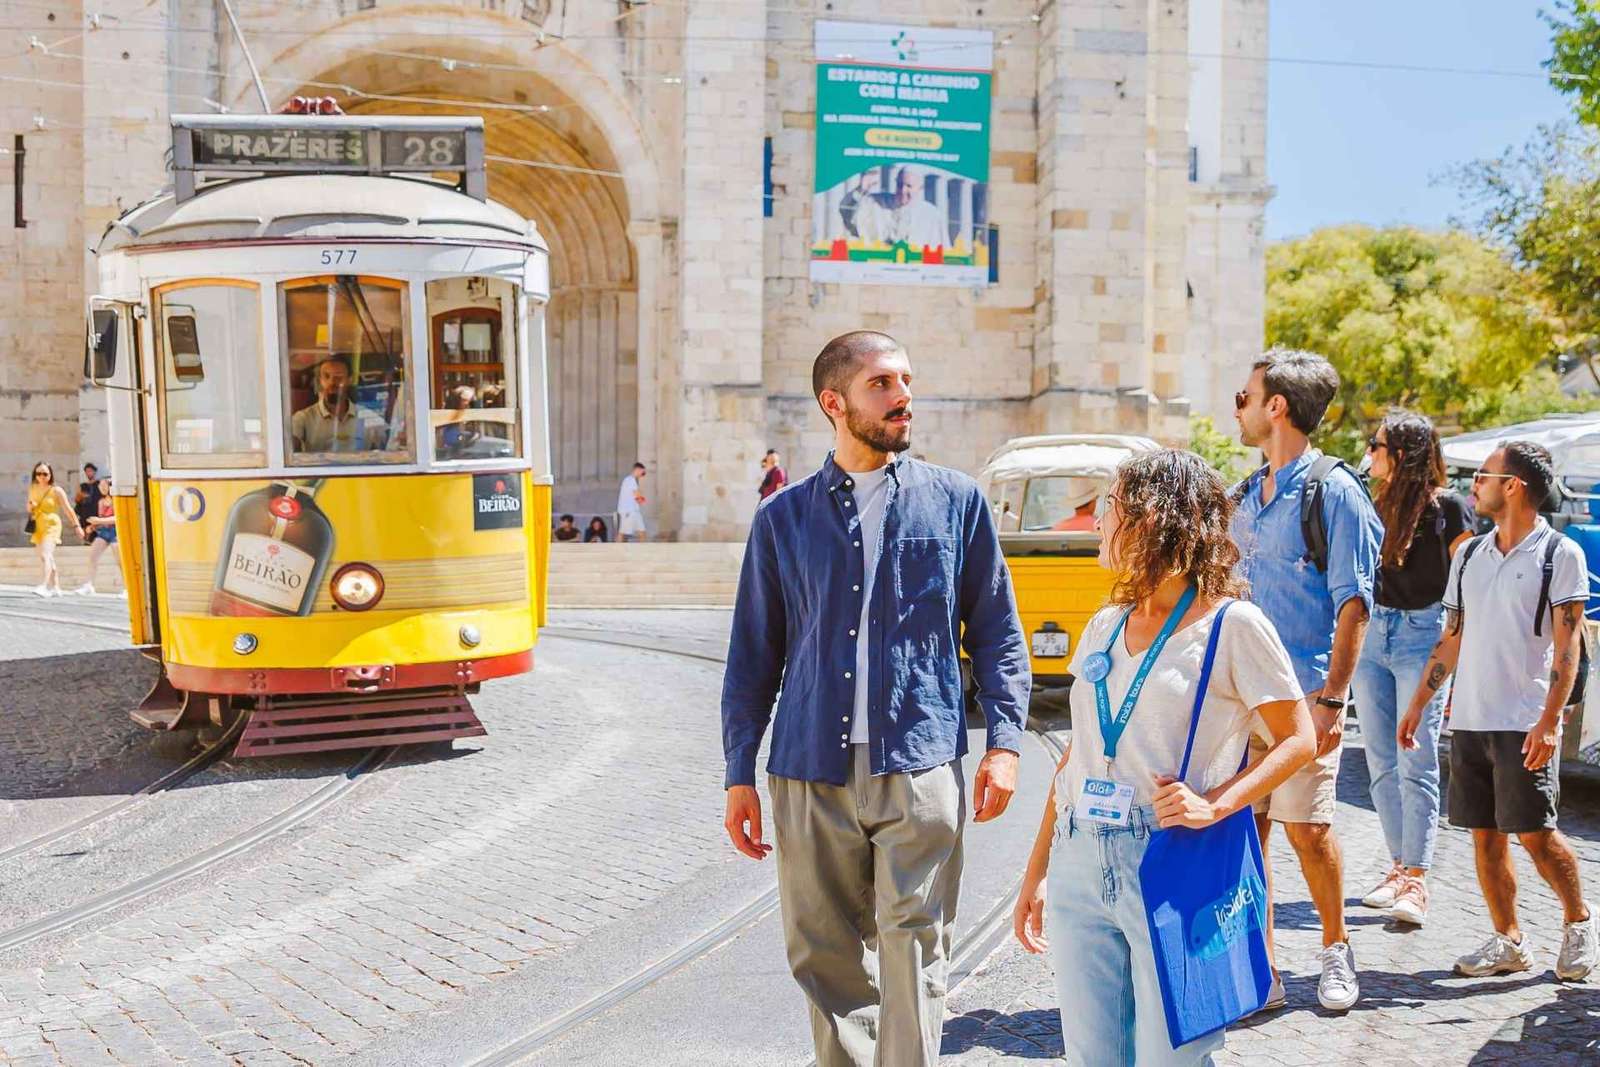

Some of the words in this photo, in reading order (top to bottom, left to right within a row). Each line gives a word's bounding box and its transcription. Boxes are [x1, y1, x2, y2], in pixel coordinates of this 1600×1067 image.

[828, 67, 898, 85] ESTAMOS
[899, 72, 910, 85] A
[912, 73, 980, 90] CAMINHO
[859, 83, 896, 99] COM
[897, 86, 949, 103] MARIA
[213, 132, 363, 161] PRAZERES
[403, 136, 455, 165] 28
[321, 249, 357, 265] 577
